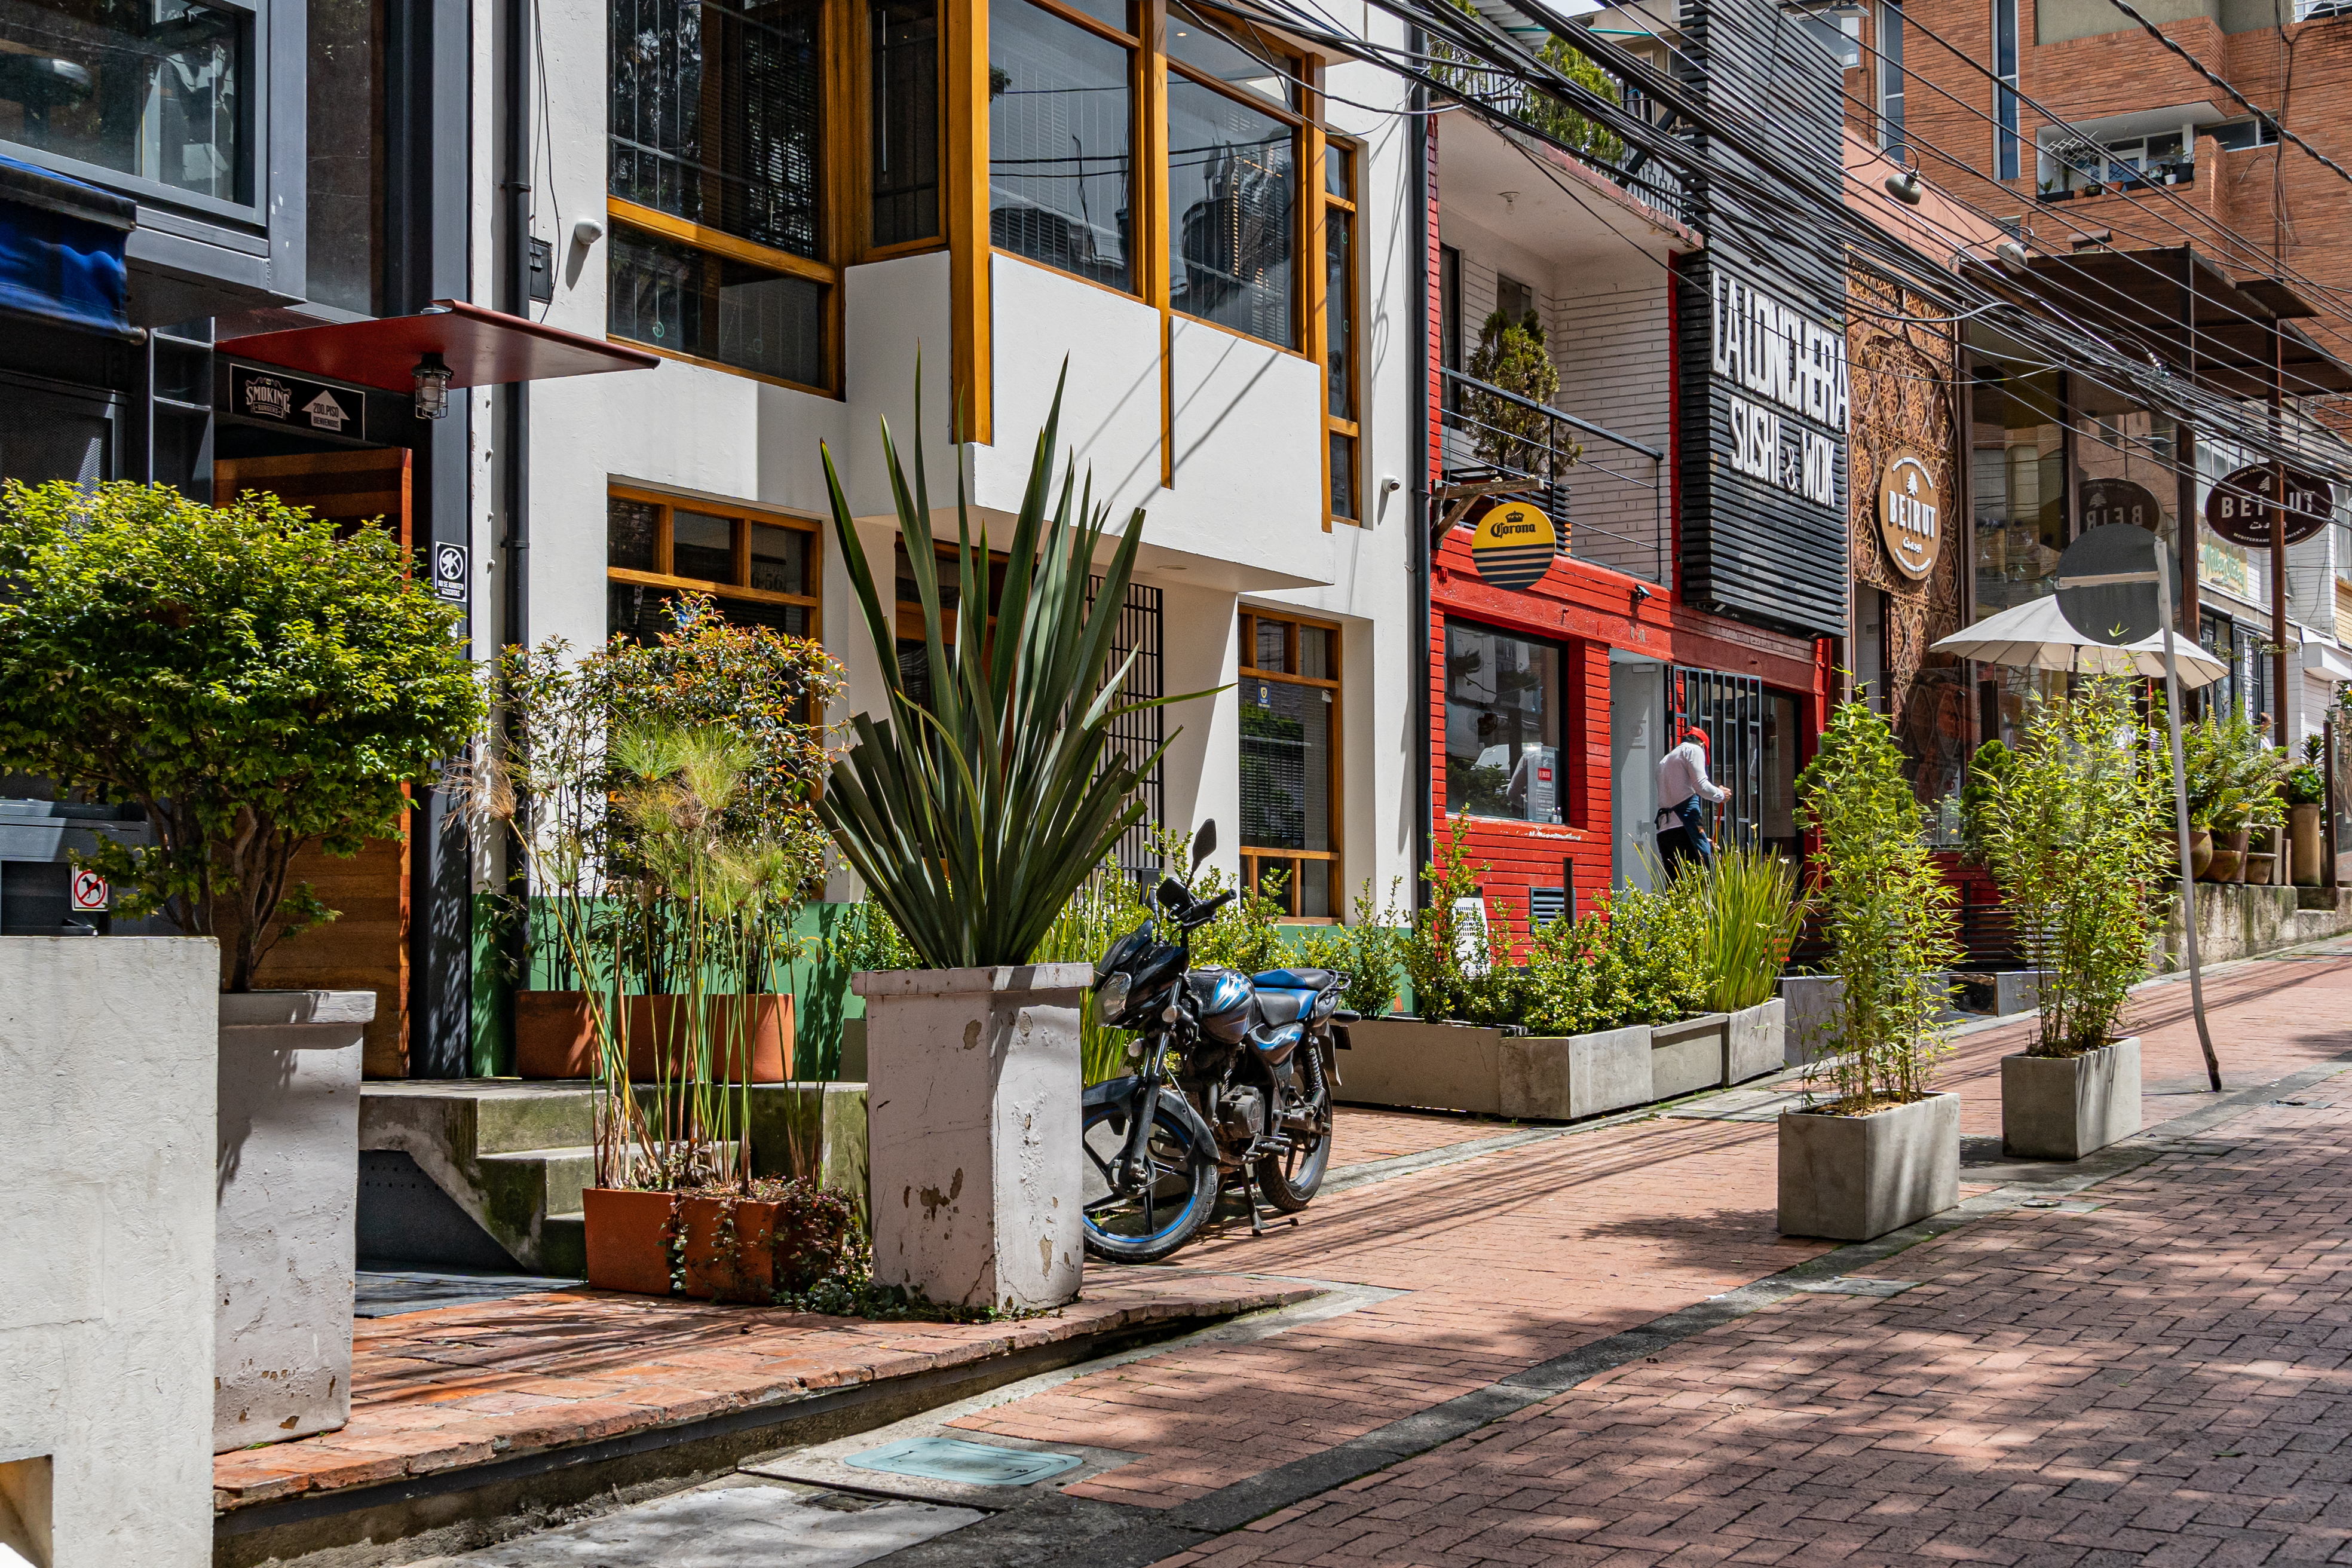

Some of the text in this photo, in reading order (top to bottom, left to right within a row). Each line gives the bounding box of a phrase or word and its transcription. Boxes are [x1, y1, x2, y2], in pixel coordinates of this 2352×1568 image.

[246, 386, 291, 414] SMOKING
[1729, 395, 1835, 508] SUSHI & WOK
[2228, 471, 2248, 483] COCINA
[1888, 490, 1936, 538] BEIRUT
[2221, 491, 2316, 518] BEIUT
[1490, 522, 1536, 539] Corona
[2233, 532, 2270, 543] MEDITERRANE
[2284, 526, 2306, 539] ORIENTE
